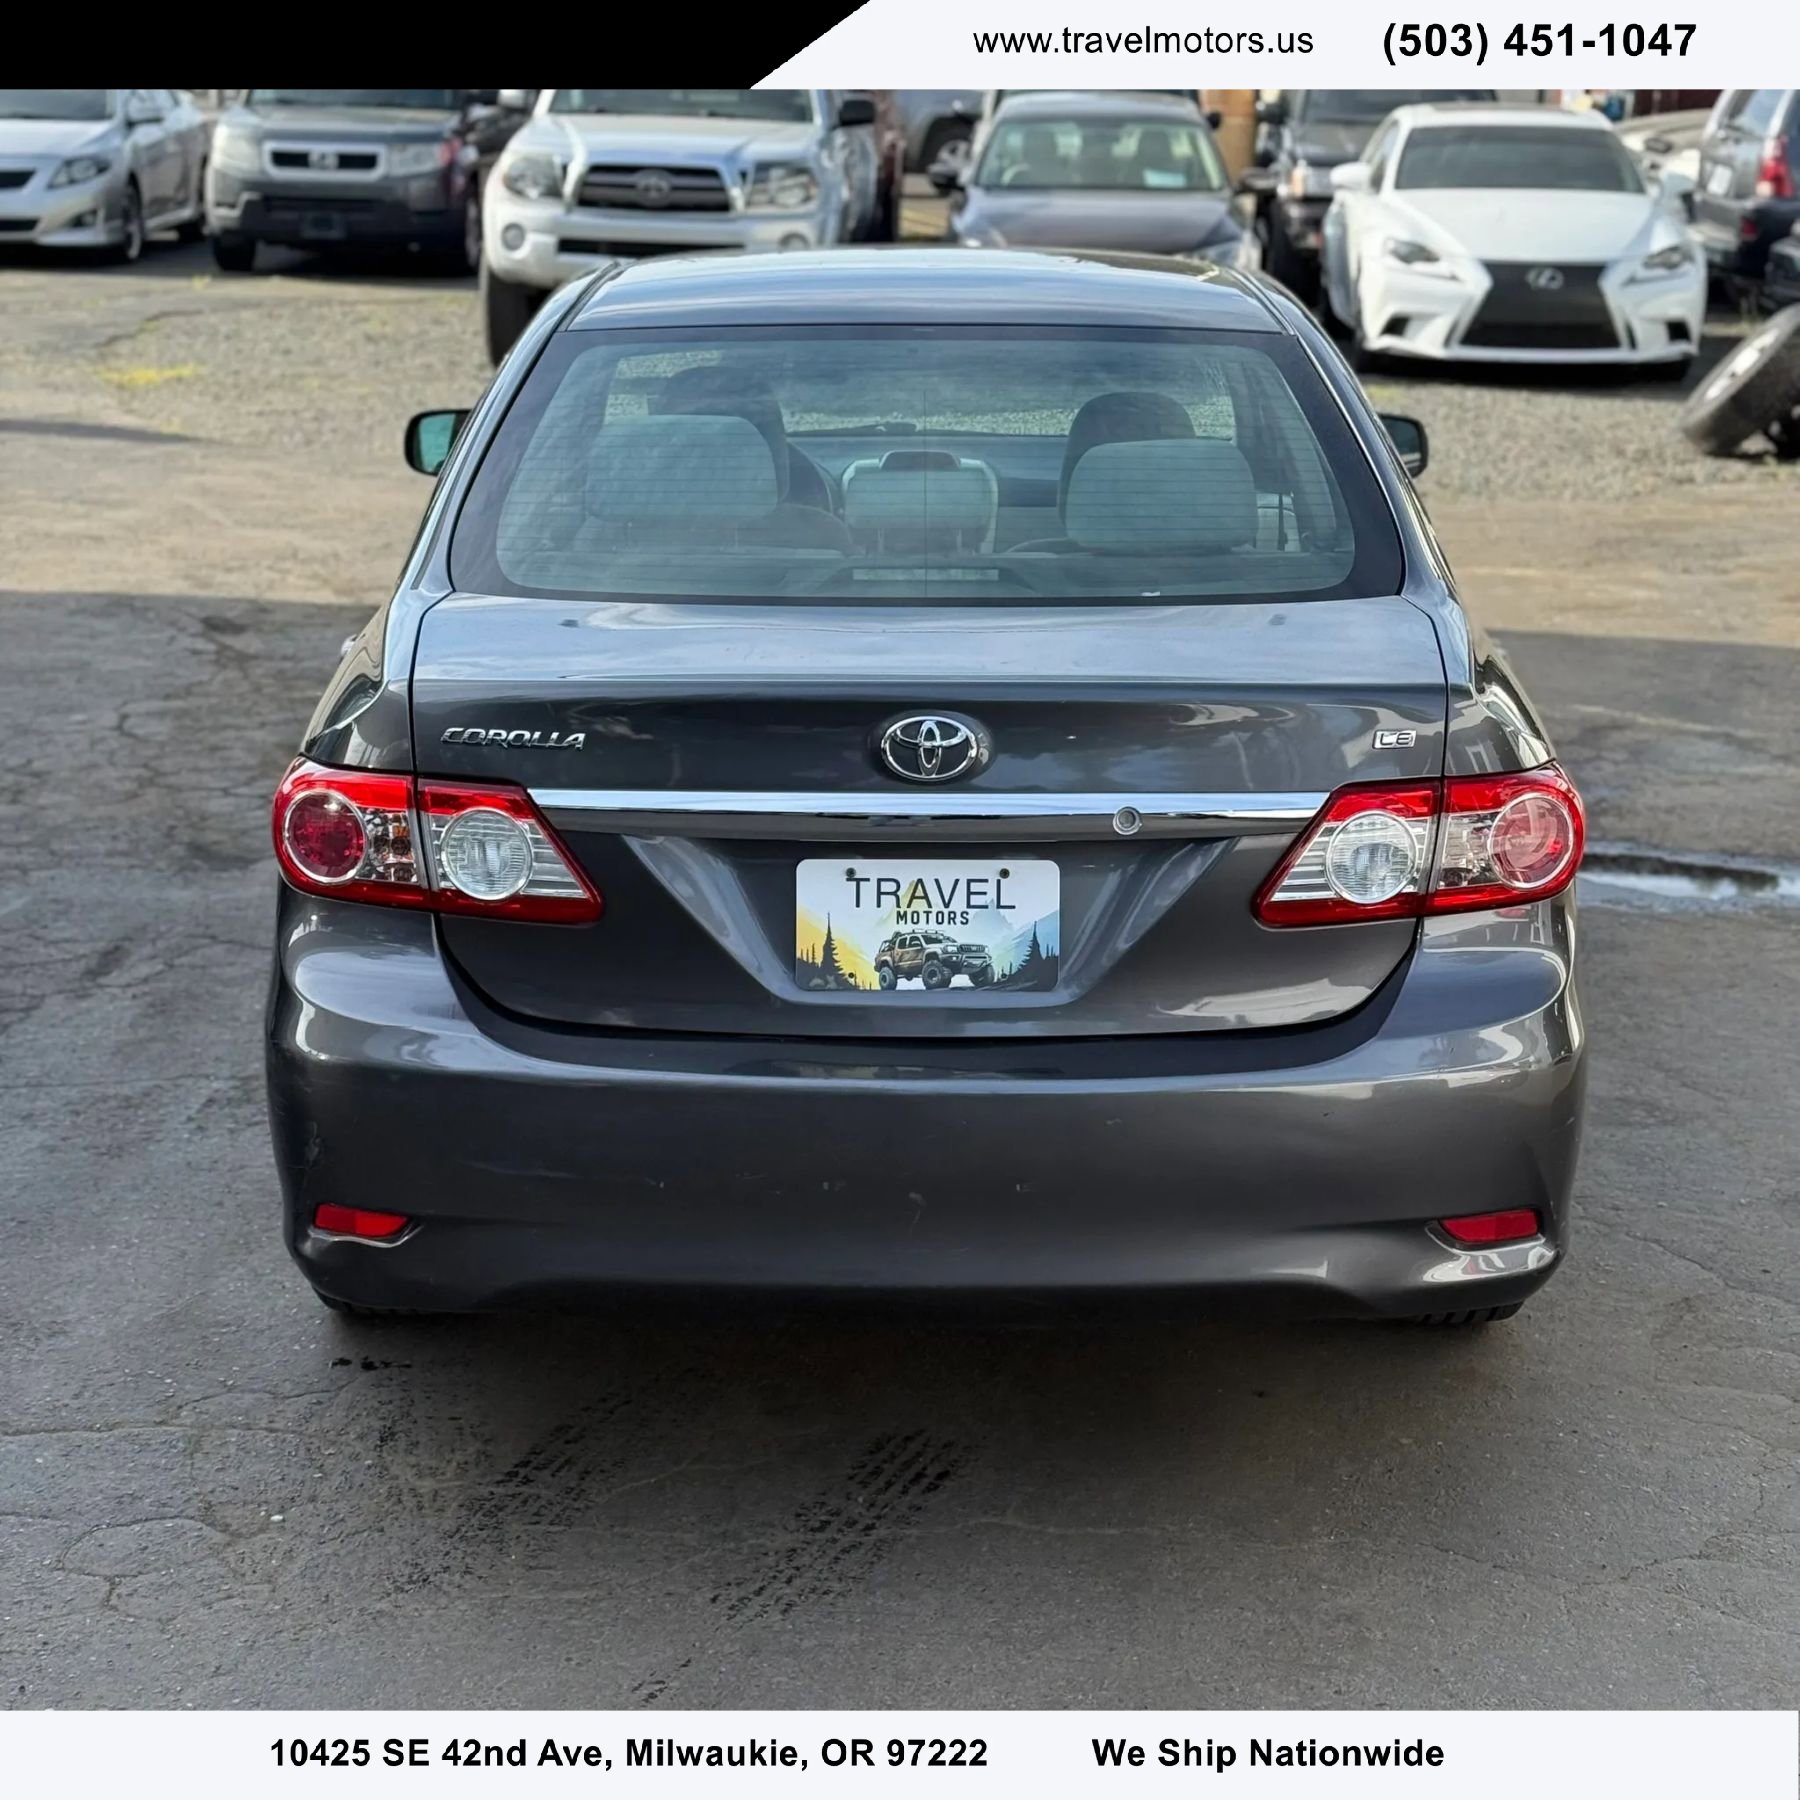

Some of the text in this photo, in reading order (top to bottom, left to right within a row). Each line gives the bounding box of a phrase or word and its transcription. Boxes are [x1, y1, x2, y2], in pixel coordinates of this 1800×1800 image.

[440, 727, 586, 749] COROLLA
[1378, 731, 1413, 747] LE
[846, 876, 1016, 910] TRAVEL
[896, 910, 969, 926] MOTORS
